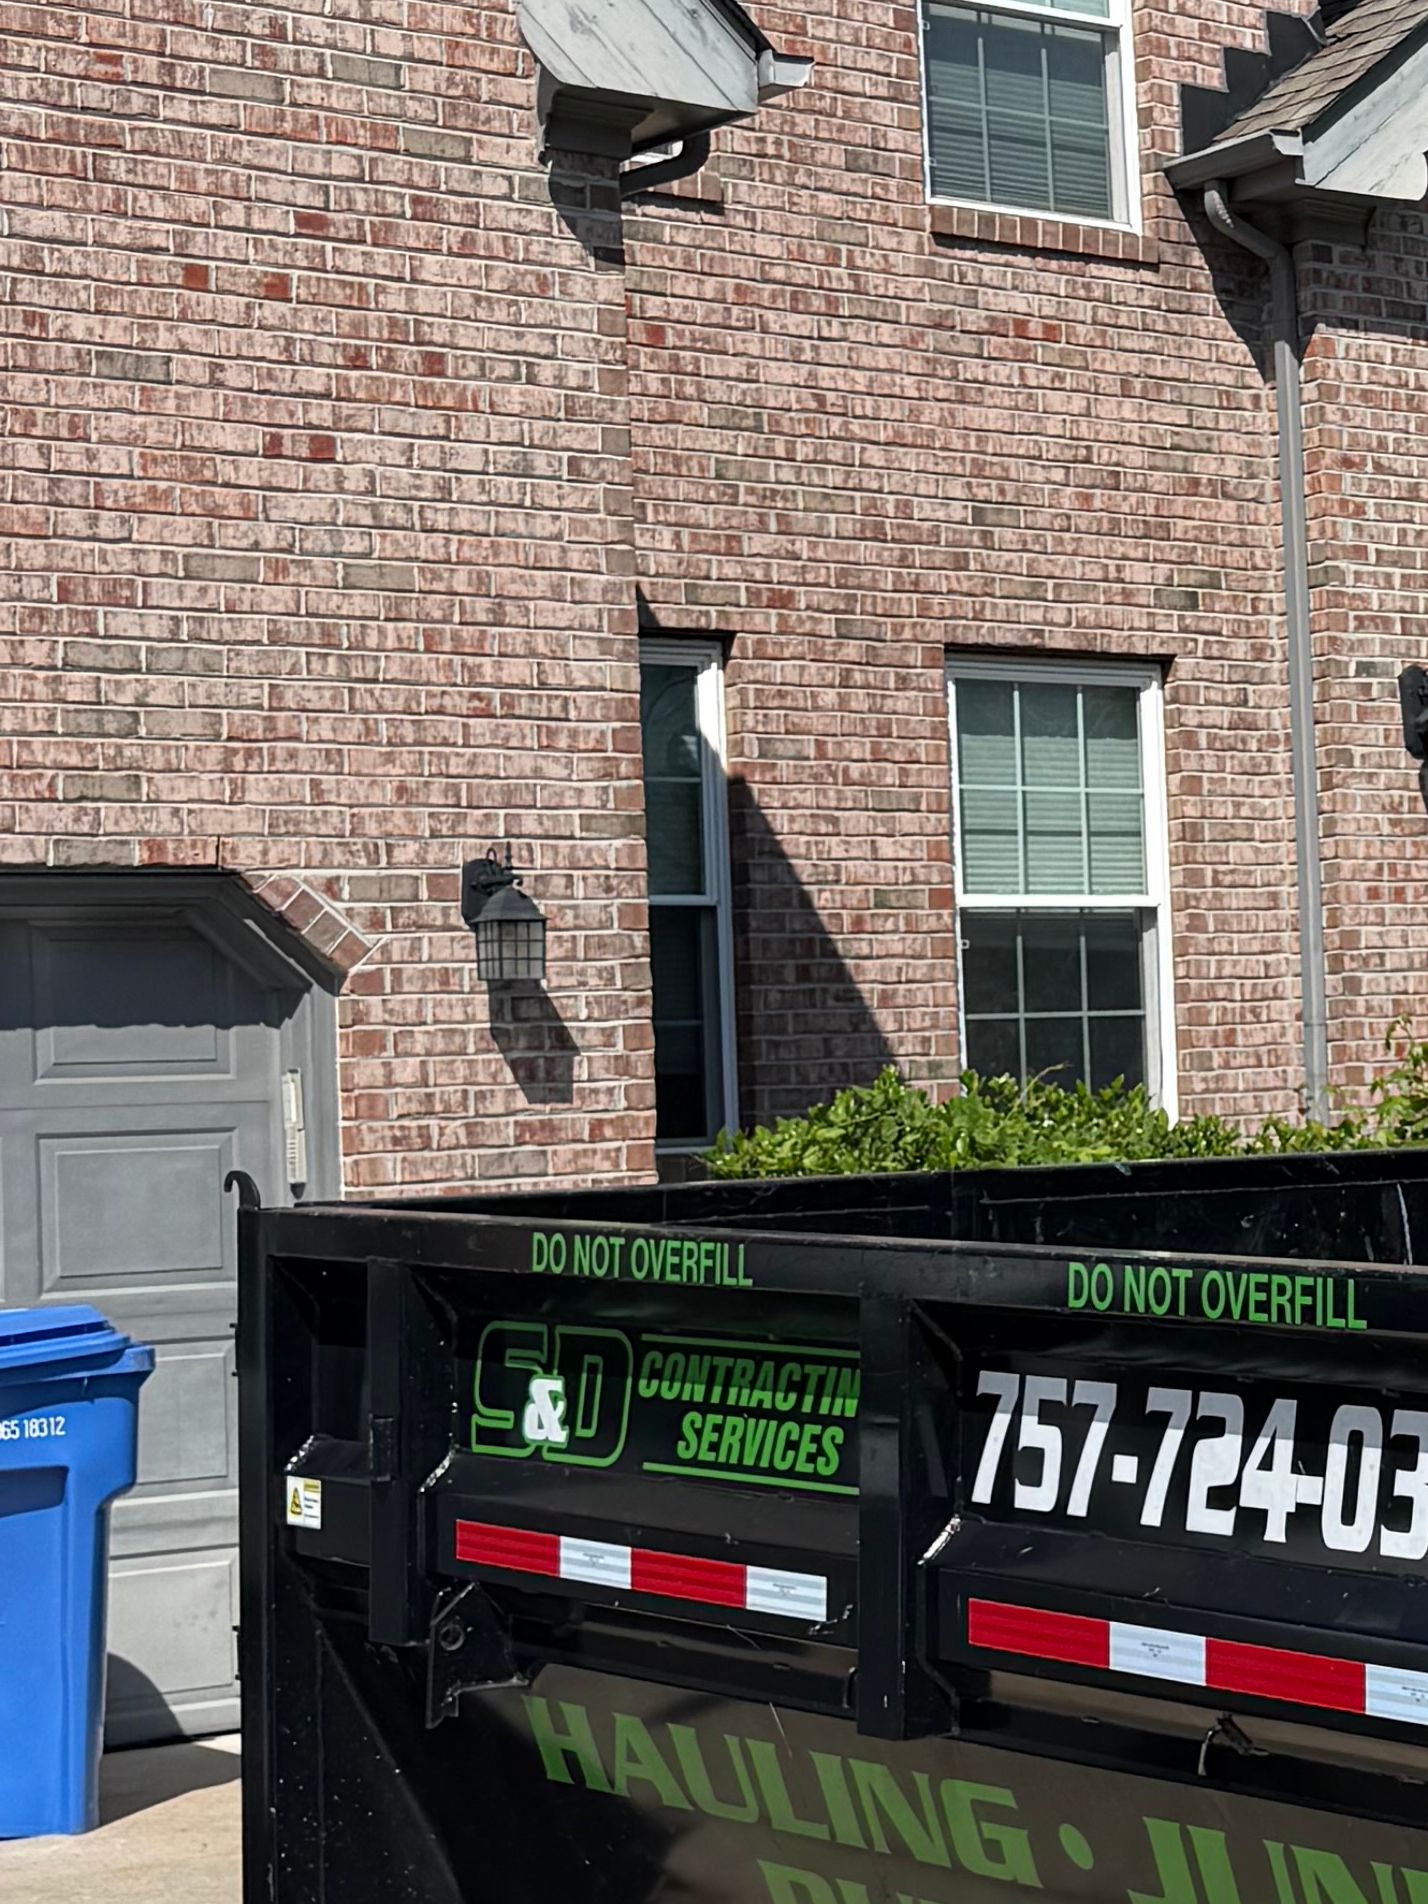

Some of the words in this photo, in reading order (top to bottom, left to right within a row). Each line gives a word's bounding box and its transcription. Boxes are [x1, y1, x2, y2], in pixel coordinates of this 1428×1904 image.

[531, 1232, 567, 1275] DO
[573, 1234, 626, 1279] NOT
[630, 1238, 753, 1287] OVERFILL
[1068, 1261, 1115, 1310] DO
[1123, 1265, 1193, 1317] NOT
[1201, 1270, 1368, 1331] OVERFILL
[471, 1319, 635, 1468] S&D
[638, 1350, 861, 1418] CONTRACTIN
[0, 1420, 20, 1440] 65
[677, 1411, 845, 1477] SERVICES
[520, 1694, 1045, 1888] HAULING
